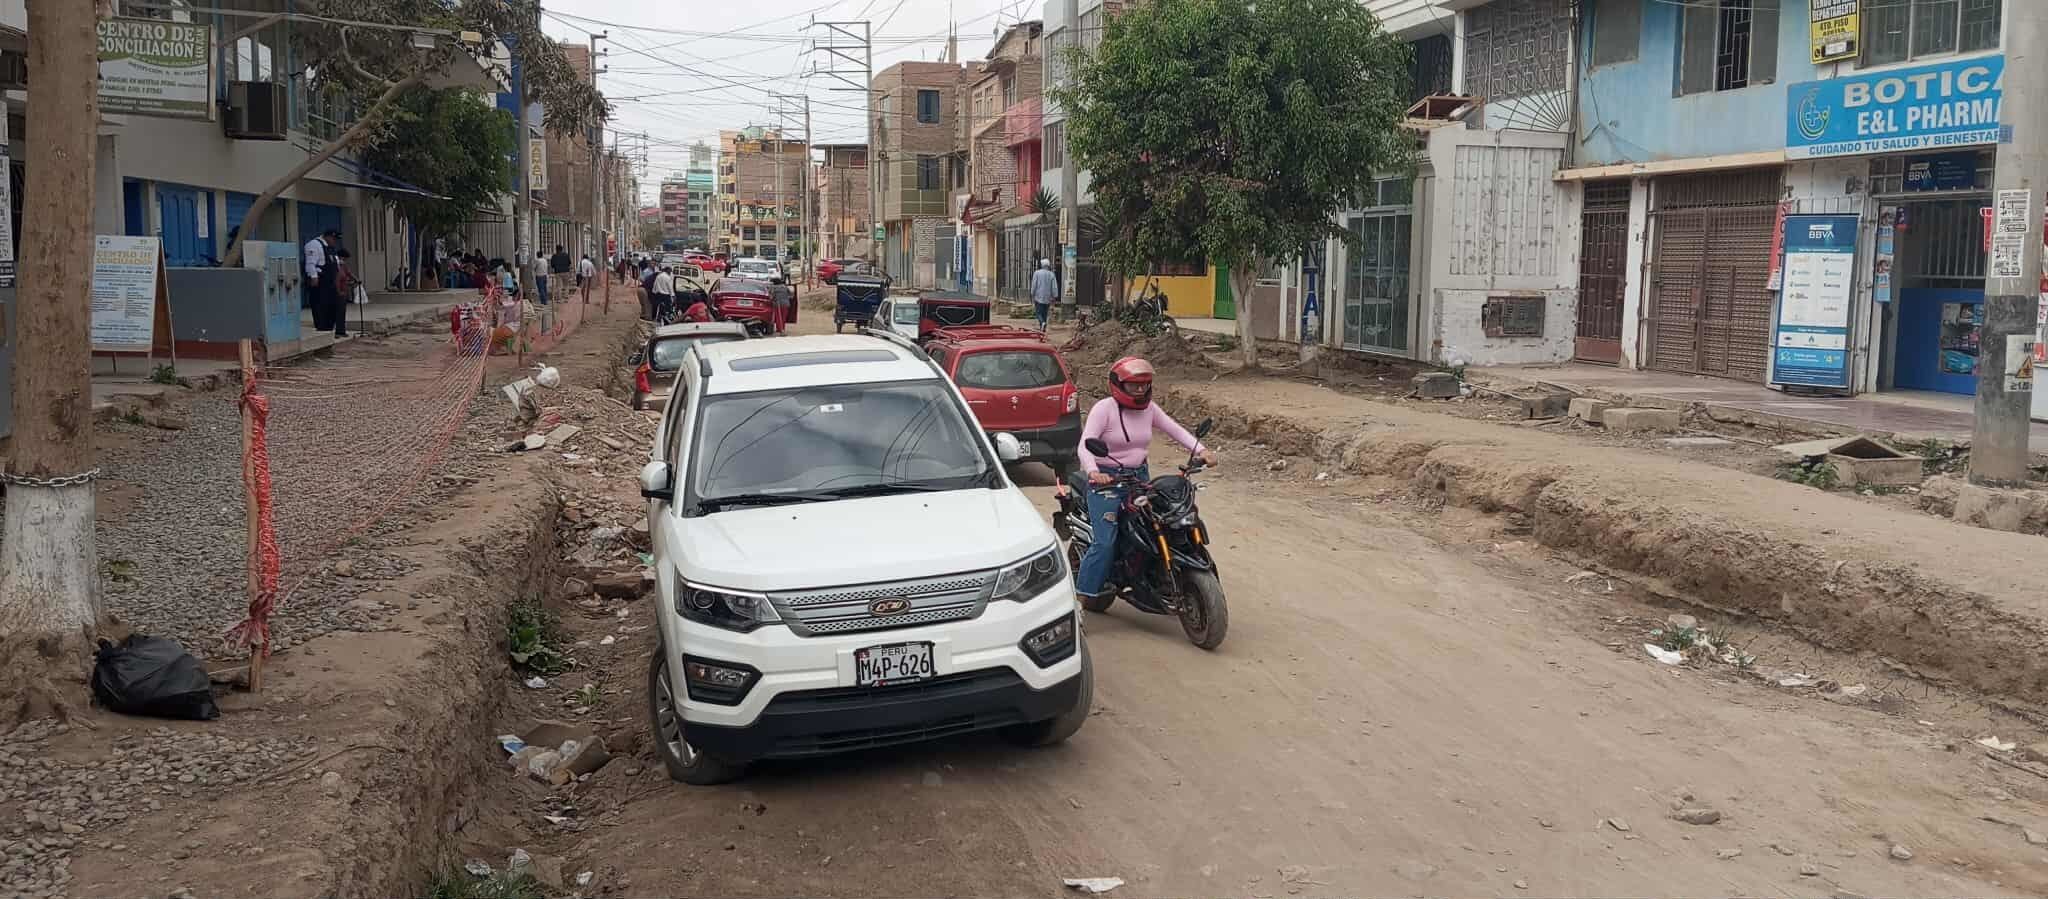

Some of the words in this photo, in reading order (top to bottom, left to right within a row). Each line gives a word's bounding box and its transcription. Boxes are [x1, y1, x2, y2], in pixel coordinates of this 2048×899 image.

[1812, 2, 1857, 22] DEPARTAMENTO
[97, 21, 167, 40] CENTRO
[171, 26, 195, 42] DE
[97, 37, 195, 58] CONCILIACION
[1857, 108, 1899, 135] E&L
[1808, 142, 1862, 156] CUIDANDO
[1865, 140, 1881, 151] TU
[1882, 138, 1919, 150] SALUD
[1923, 136, 1931, 146] Y
[1908, 169, 1932, 181] BBVA
[1808, 230, 1835, 239] BBVA
[881, 647, 908, 656] PERU
[860, 653, 930, 681] M4P-626
